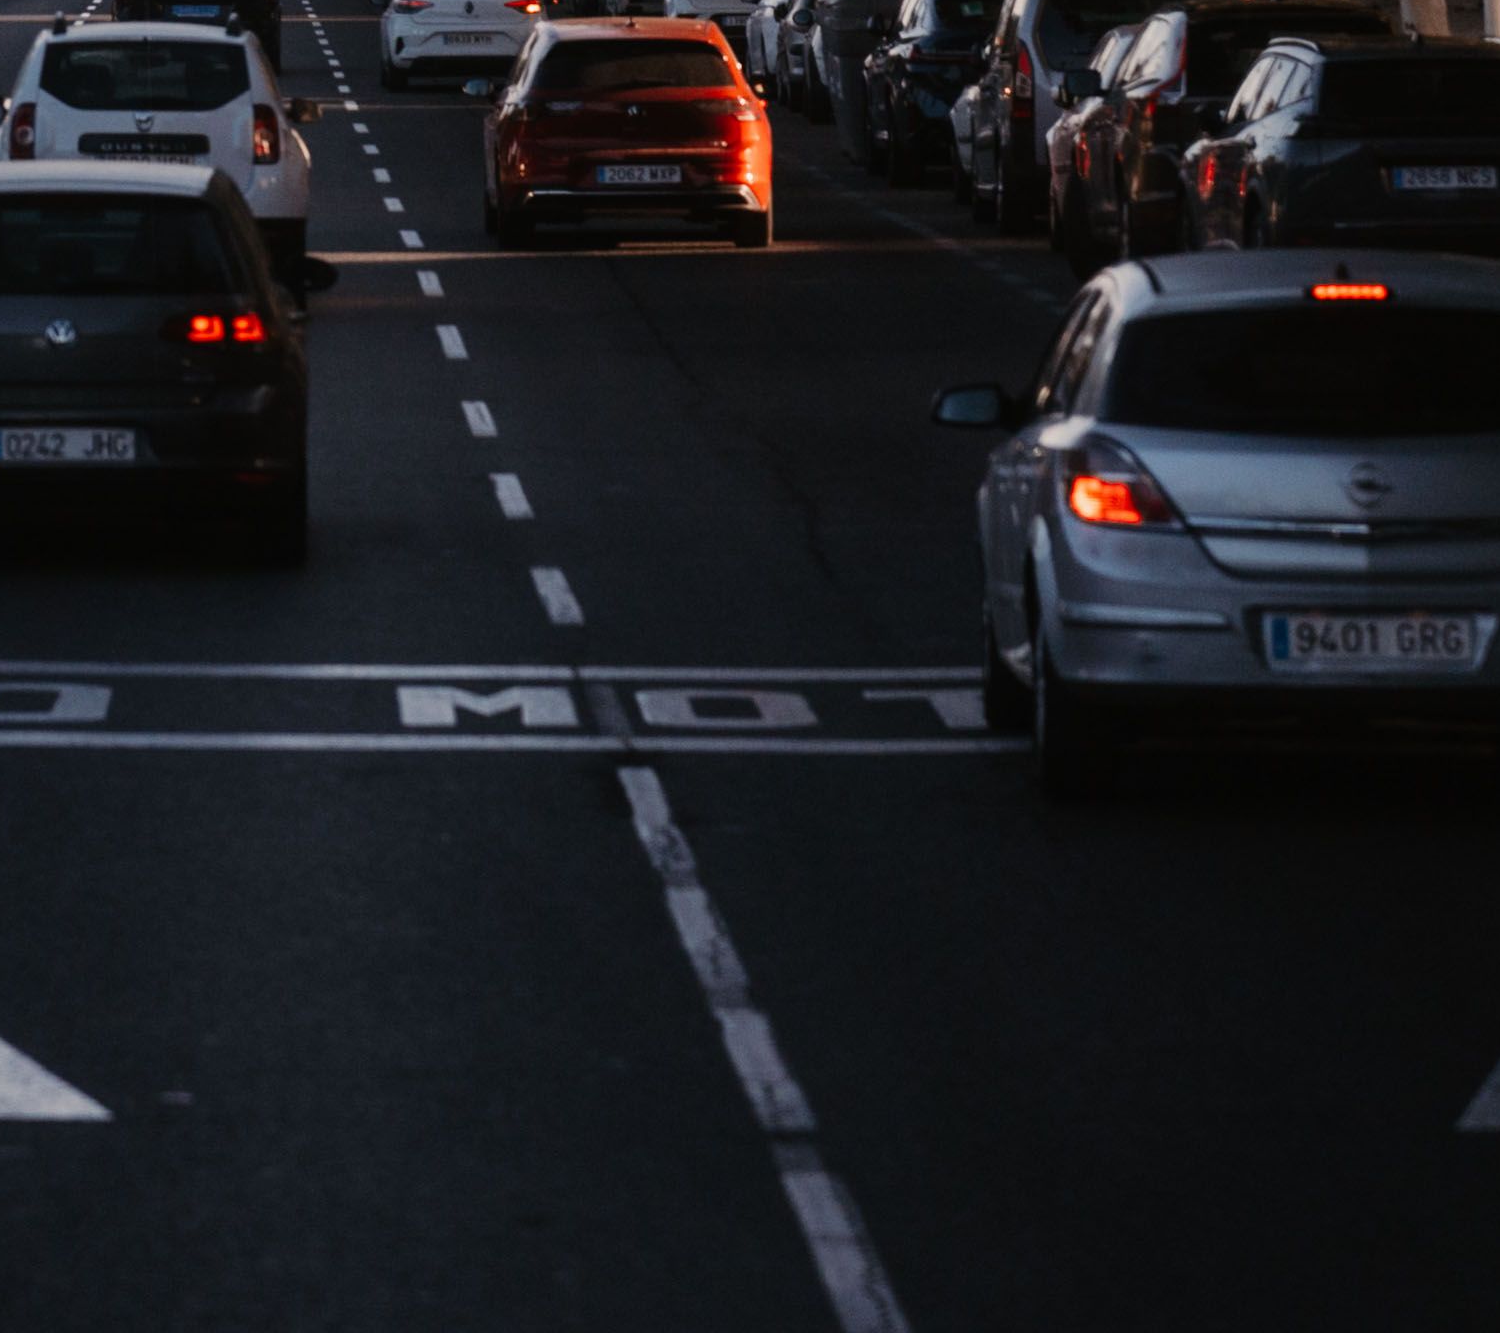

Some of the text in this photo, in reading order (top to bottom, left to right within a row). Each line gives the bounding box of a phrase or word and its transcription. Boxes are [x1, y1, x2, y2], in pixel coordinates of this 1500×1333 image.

[6, 432, 131, 457] 0242 JHG
[1295, 621, 1465, 654] 9401 GRG
